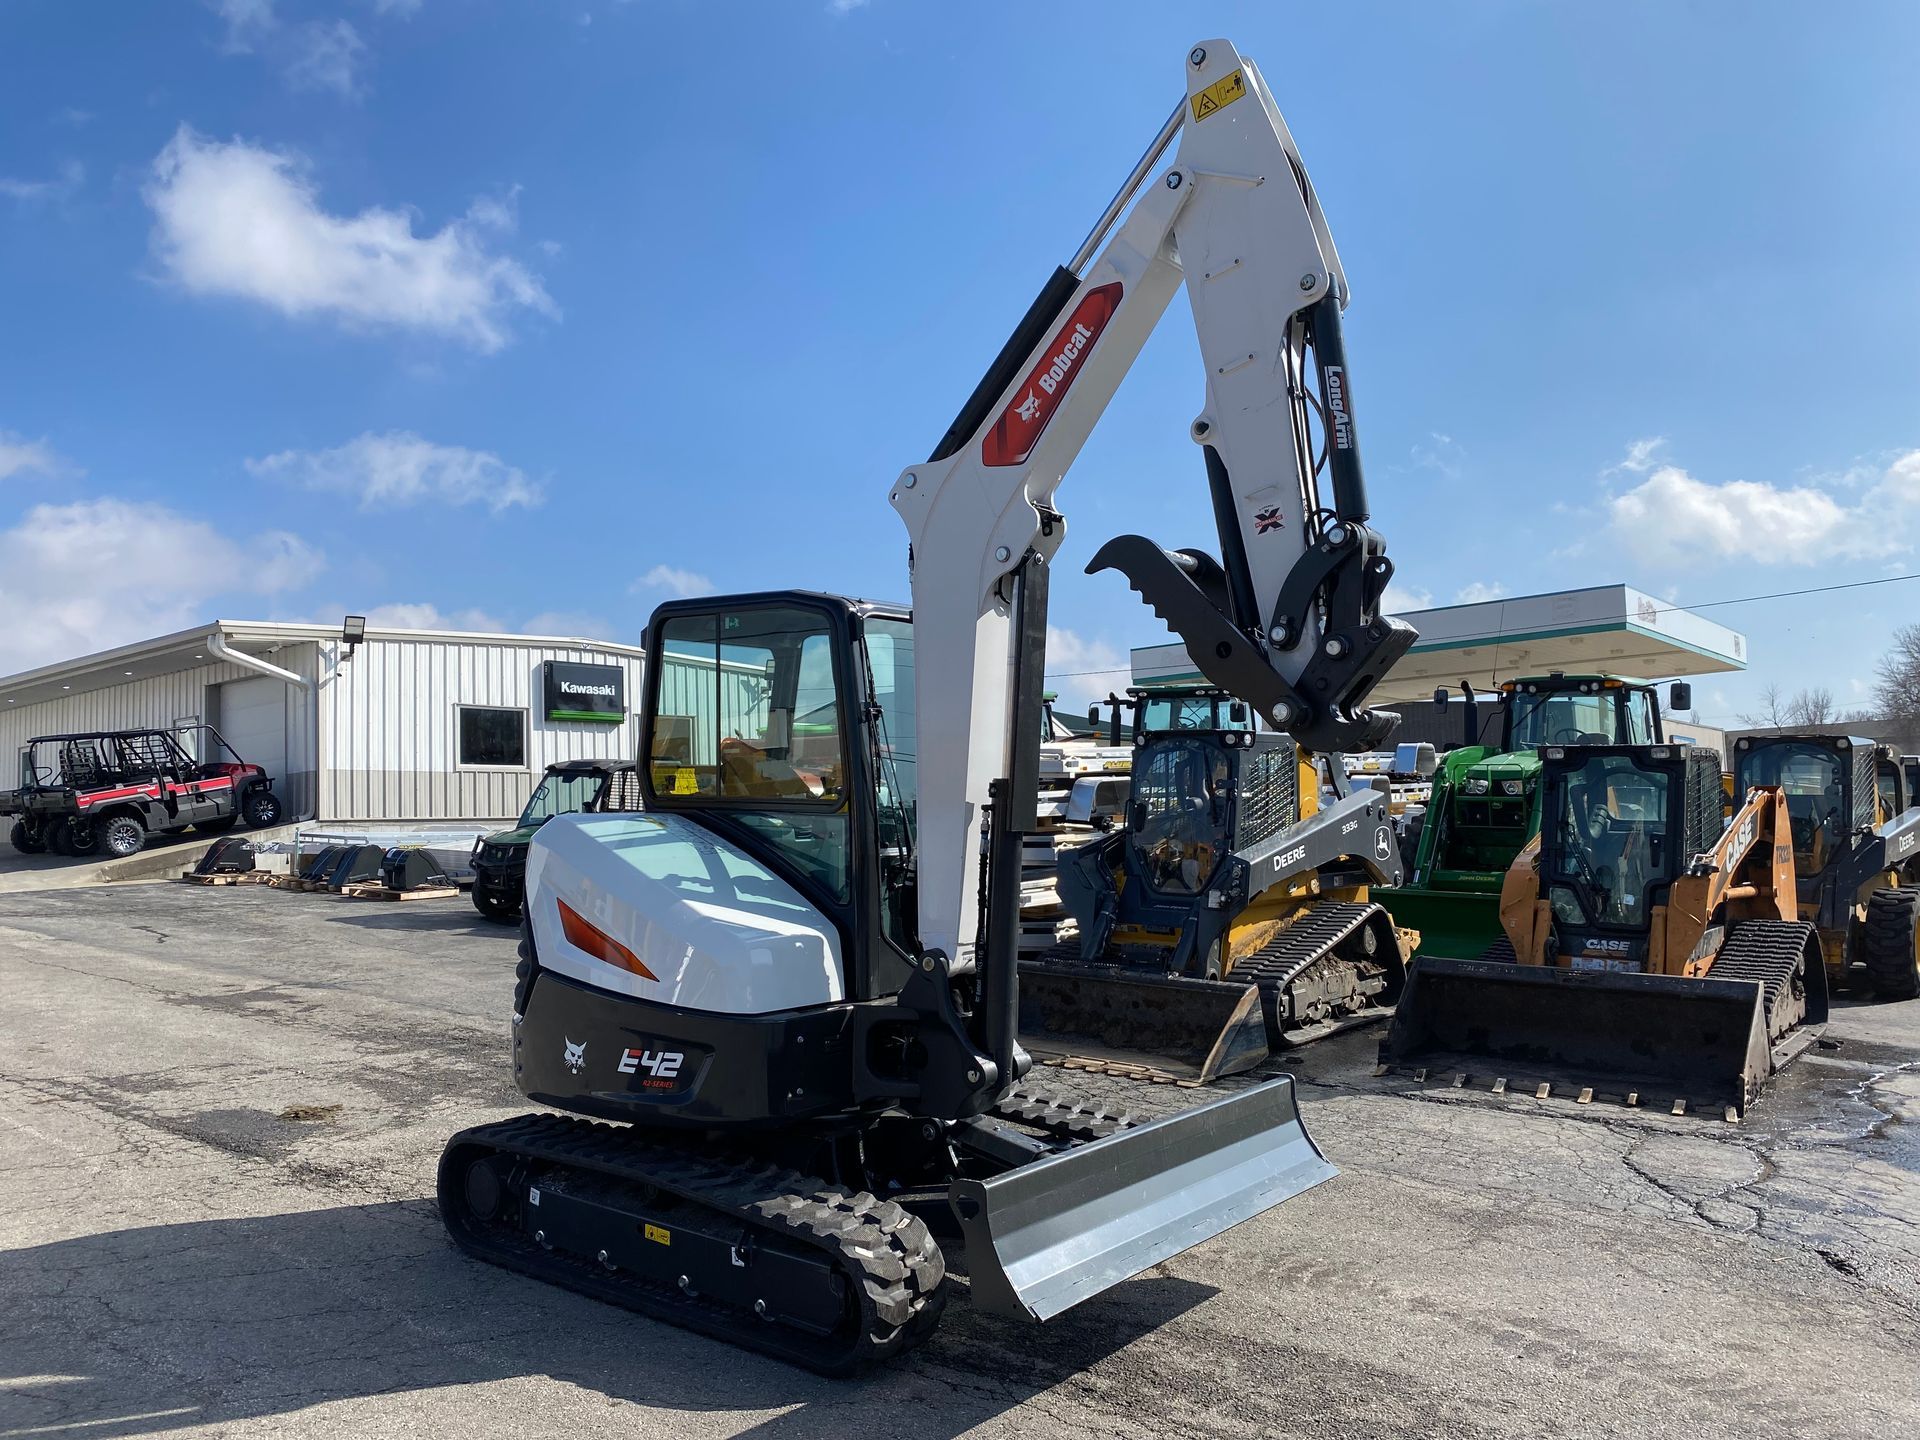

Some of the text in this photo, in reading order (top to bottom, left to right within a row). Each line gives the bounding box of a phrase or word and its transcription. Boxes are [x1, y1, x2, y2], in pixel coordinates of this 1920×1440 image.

[1038, 322, 1092, 395] Bobcat
[1327, 366, 1349, 449] LongArm
[561, 681, 615, 695] Kawasaki
[1341, 820, 1358, 835] 333G
[1726, 814, 1752, 873] CASE
[1899, 831, 1915, 853] DEERE
[1273, 845, 1306, 872] DEERE
[1586, 939, 1630, 951] CASE
[617, 1048, 684, 1078] E42
[642, 1079, 674, 1089] R2-SERIES
